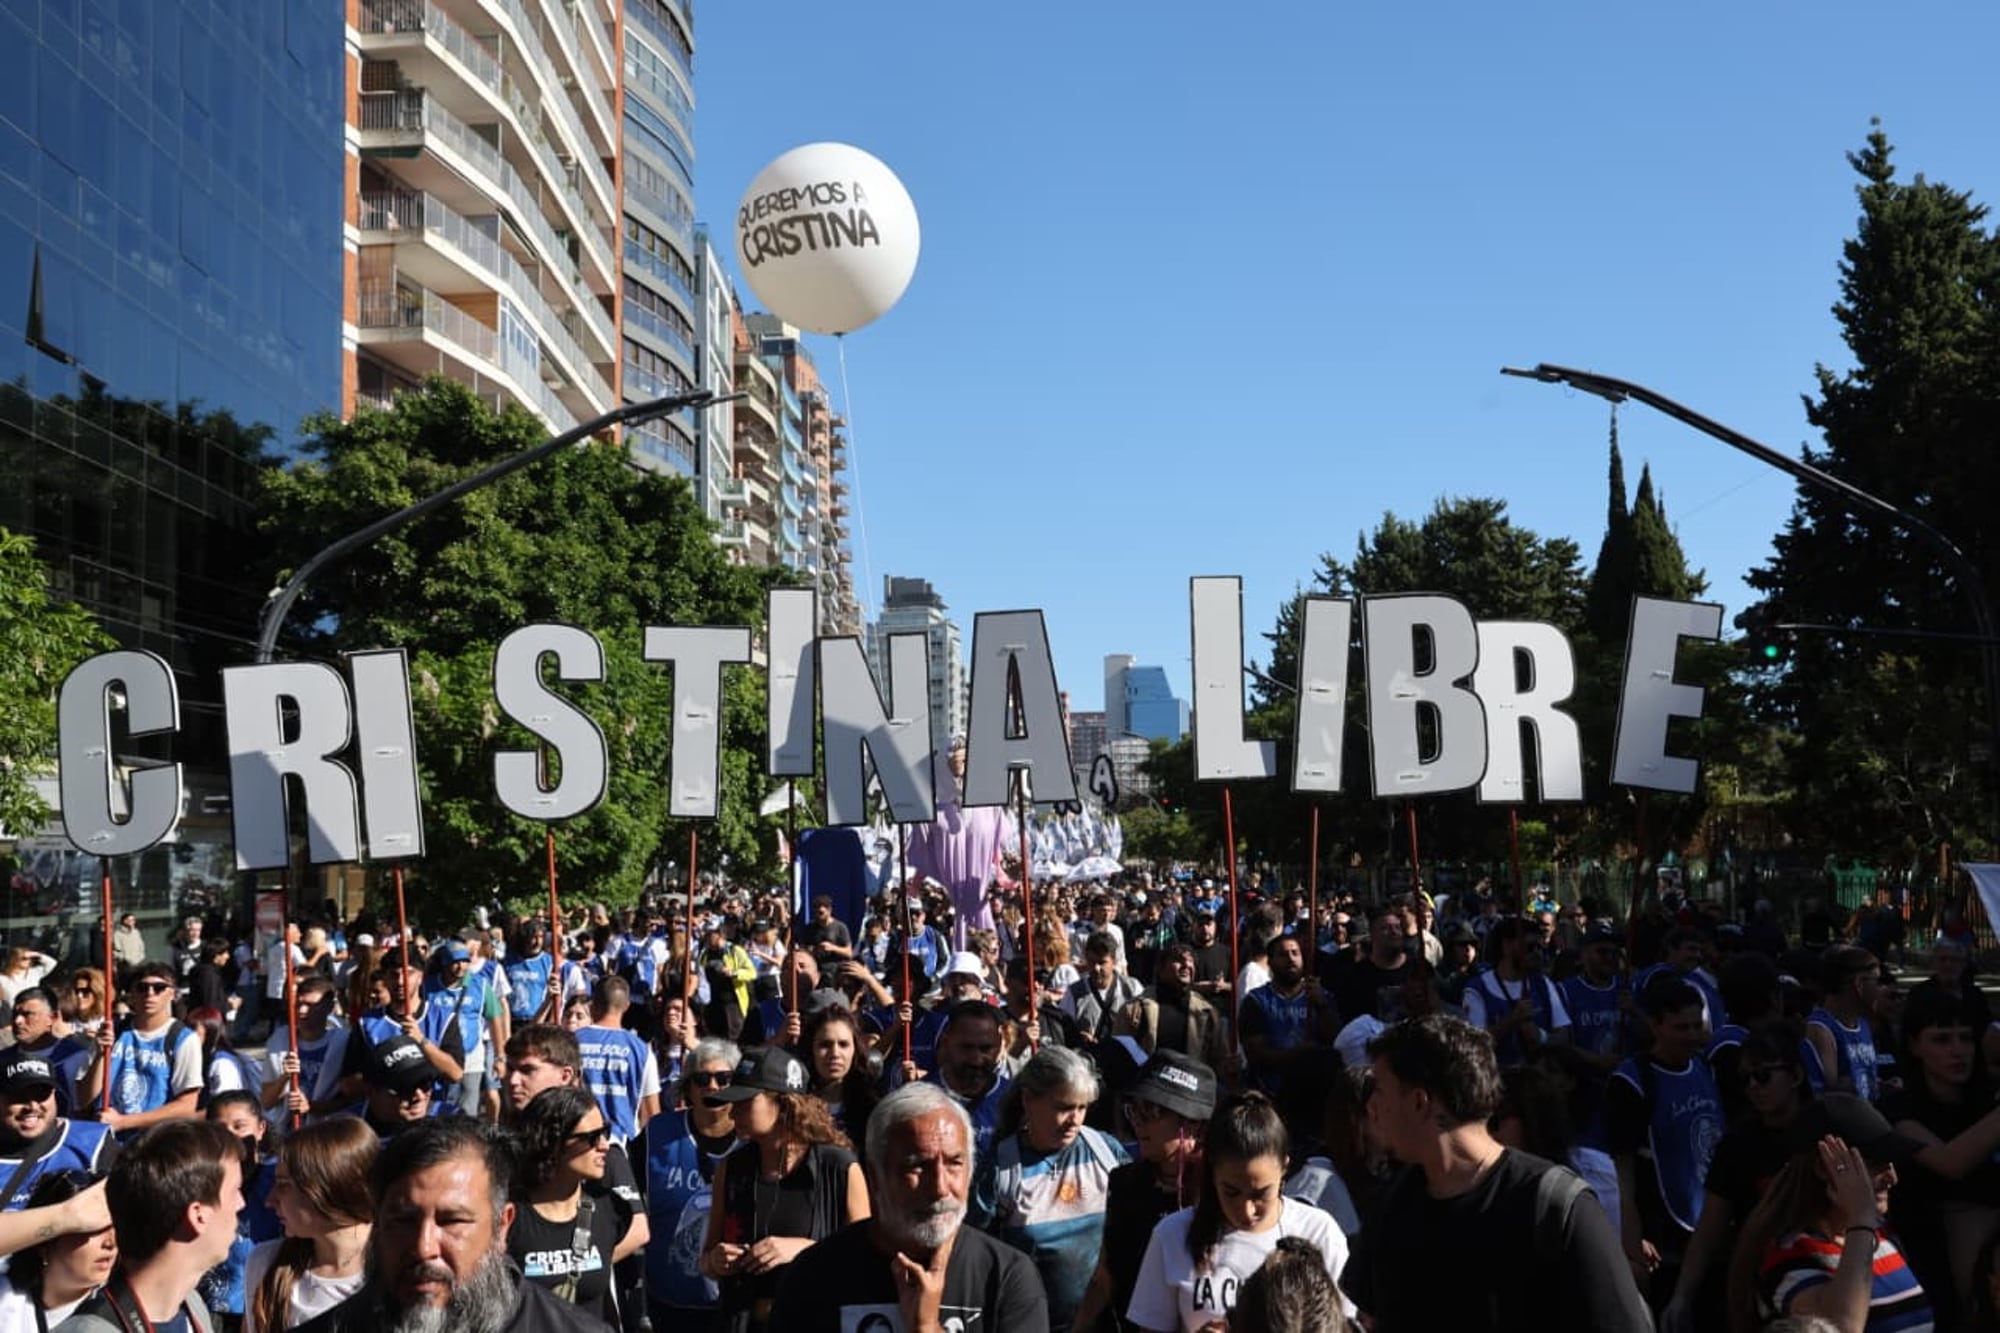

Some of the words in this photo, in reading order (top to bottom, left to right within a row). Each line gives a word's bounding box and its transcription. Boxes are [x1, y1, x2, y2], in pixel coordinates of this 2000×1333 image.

[738, 182, 847, 229] QUEREMOS
[742, 208, 880, 267] CRISTINA
[57, 585, 1080, 871] CRISTINA
[1189, 575, 1724, 803] LIBRE
[525, 1245, 601, 1265] CRISTA
[1193, 1277, 1215, 1311] LA
